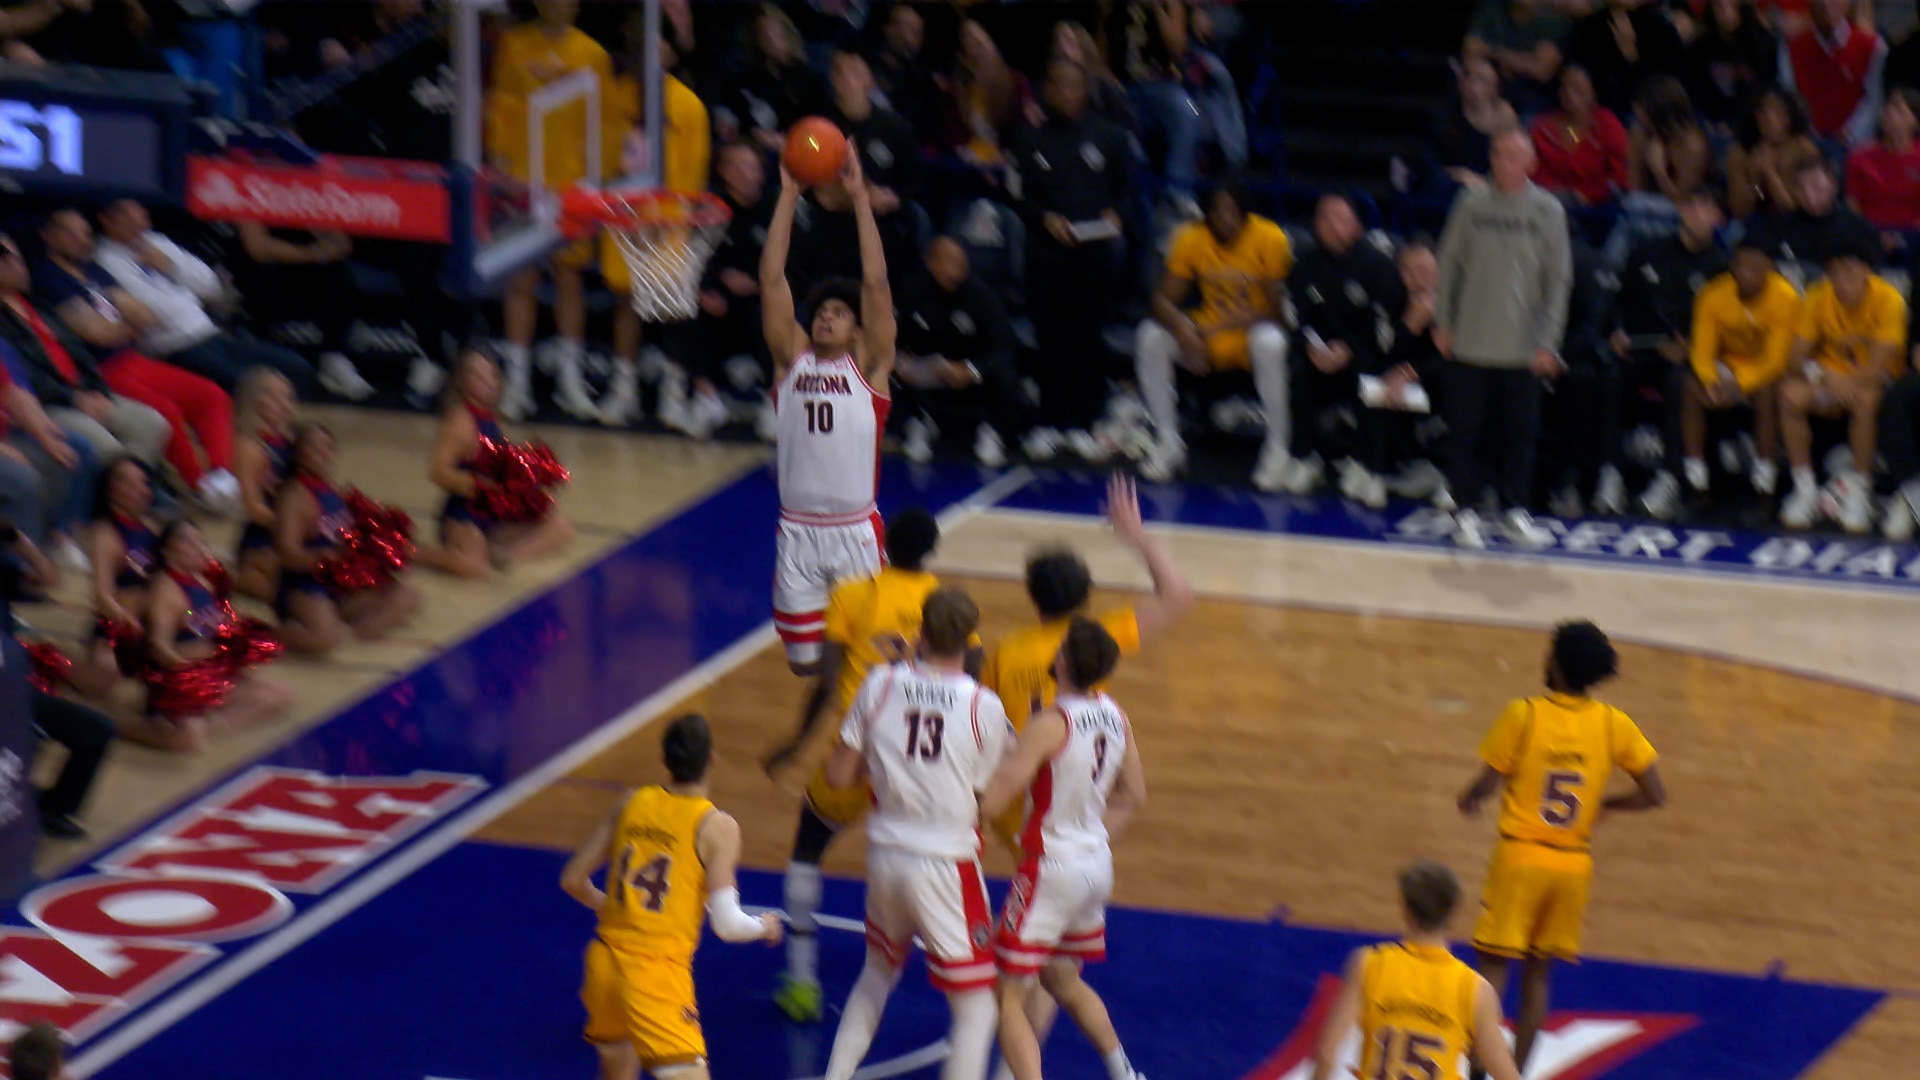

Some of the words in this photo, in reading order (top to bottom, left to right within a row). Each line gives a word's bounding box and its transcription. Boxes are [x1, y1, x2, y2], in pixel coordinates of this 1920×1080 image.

[792, 373, 853, 396] ARIZONA
[803, 400, 835, 434] 10
[904, 709, 945, 761] 13
[1540, 768, 1586, 829] 5
[615, 841, 675, 914] 14
[1371, 1023, 1449, 1080] 15
